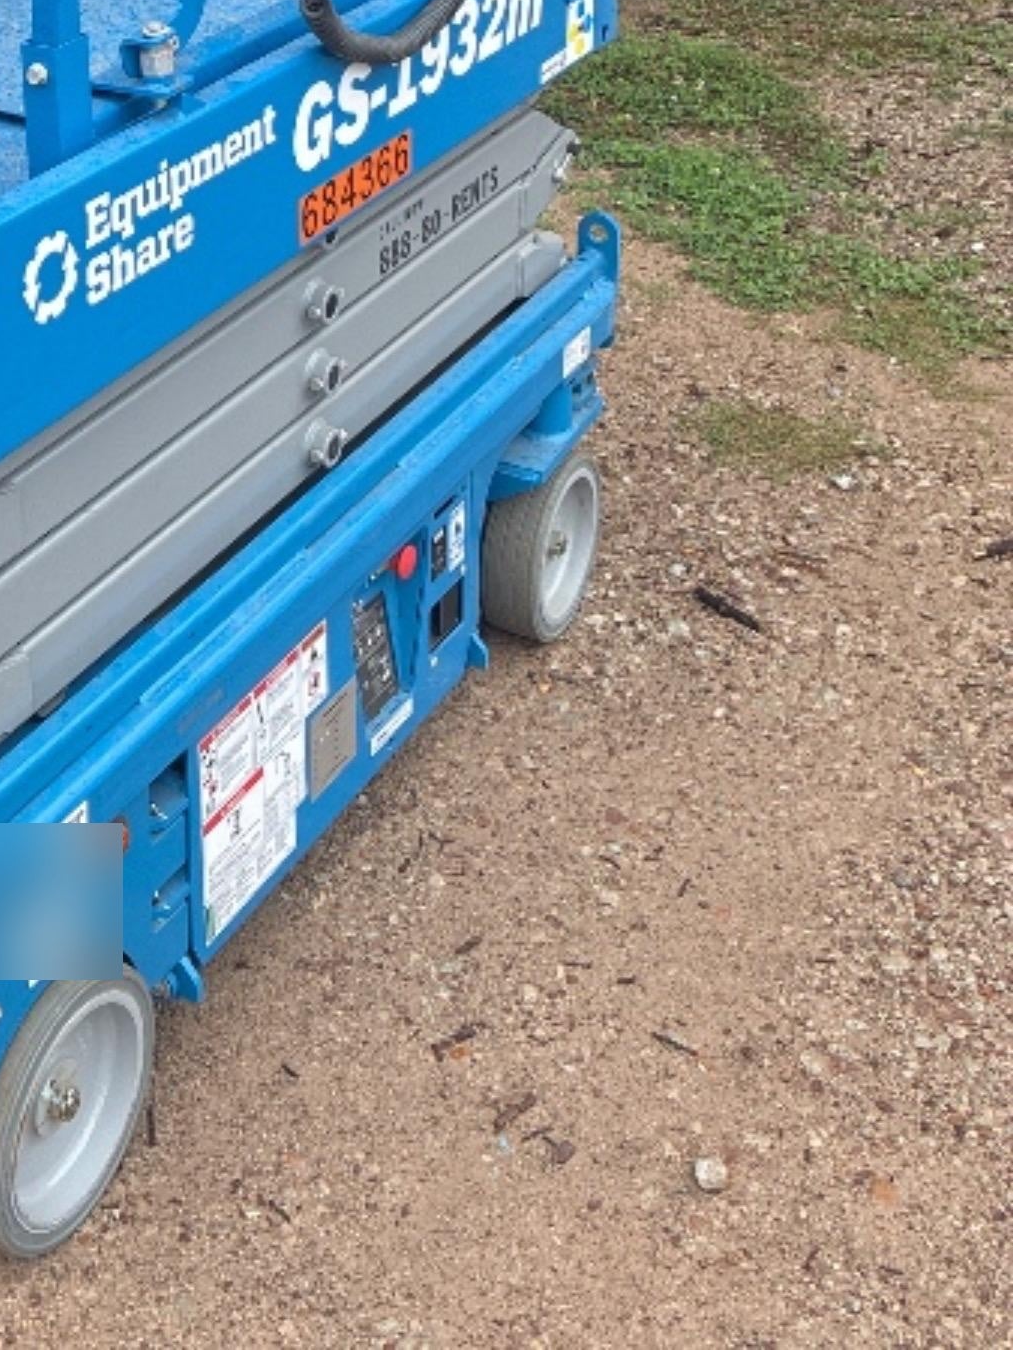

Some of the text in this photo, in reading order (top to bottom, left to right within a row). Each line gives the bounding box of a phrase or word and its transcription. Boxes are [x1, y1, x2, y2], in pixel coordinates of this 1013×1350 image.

[85, 103, 277, 250] Equipment
[301, 133, 409, 239] 684366
[85, 211, 196, 306] Share
